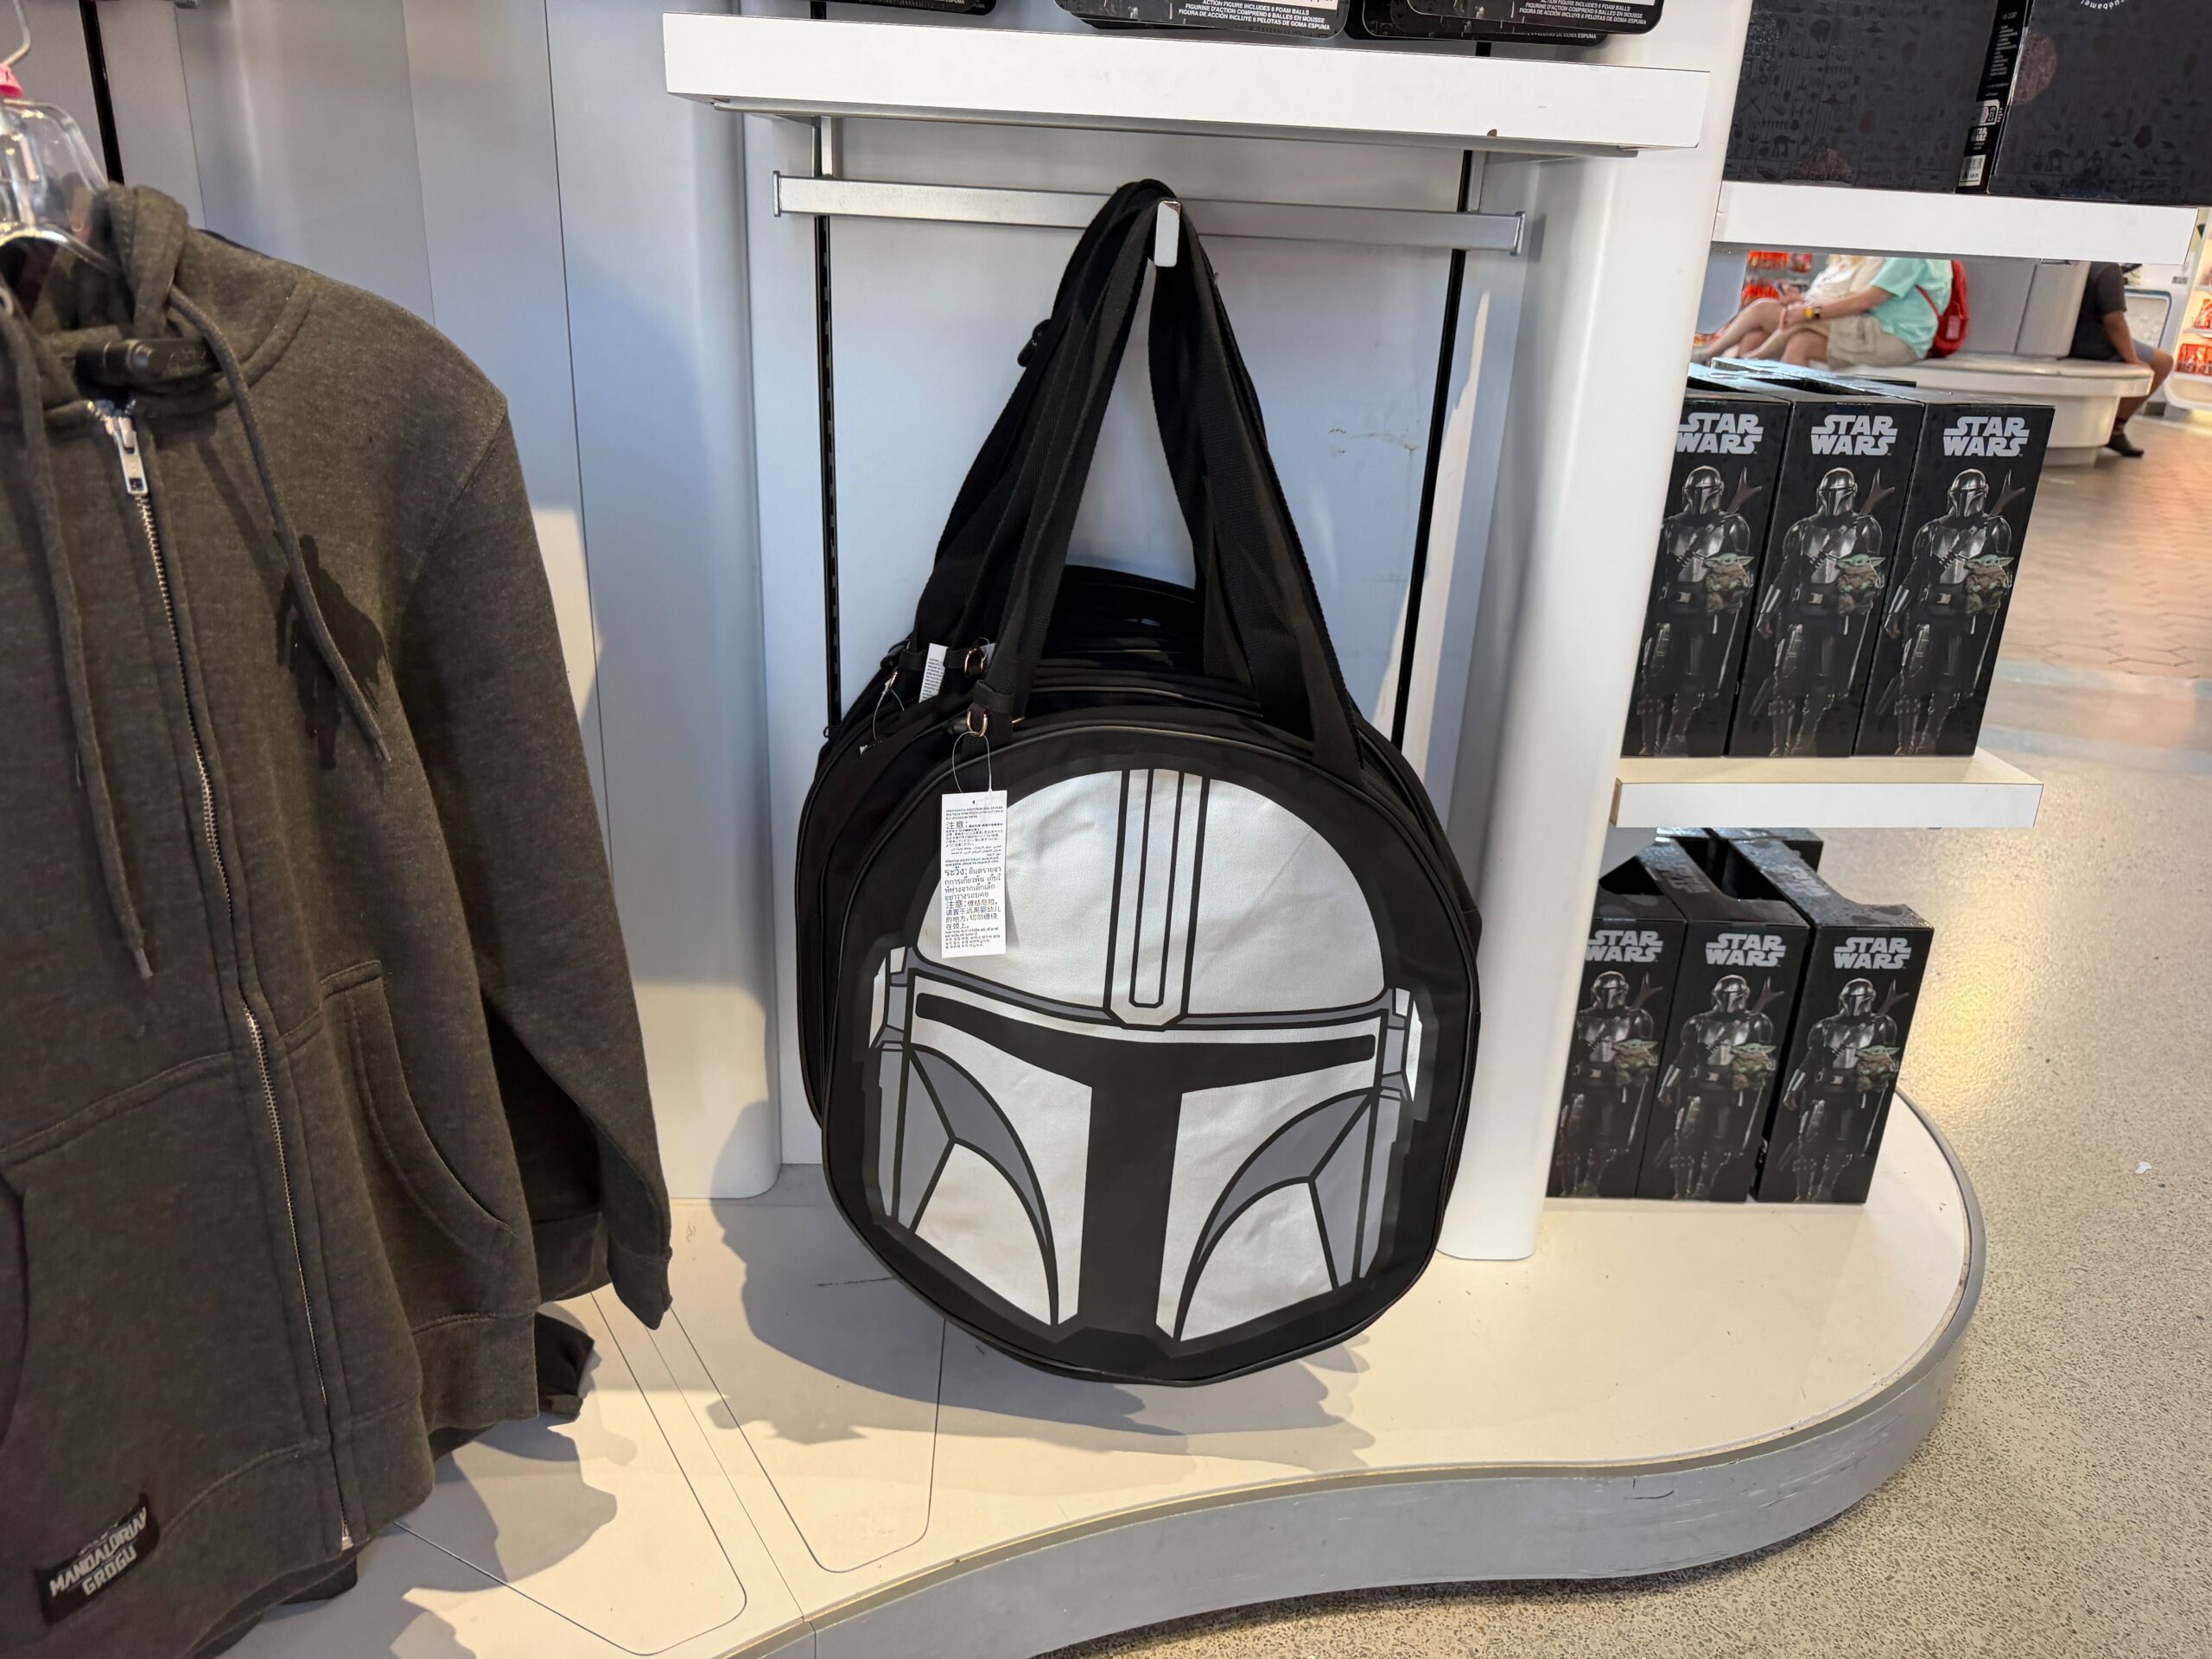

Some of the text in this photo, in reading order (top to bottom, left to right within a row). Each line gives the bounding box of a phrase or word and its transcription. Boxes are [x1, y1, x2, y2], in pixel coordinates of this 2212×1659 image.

[1211, 5, 1236, 14] D'ACTION
[1236, 8, 1267, 17] COMPREND
[1244, 3, 1270, 11] INCLUDES
[1585, 13, 1605, 22] PELOTAS
[1678, 412, 1764, 434] STAR
[1811, 415, 1898, 436] STAR
[1943, 416, 2030, 437] STAR
[1676, 432, 1763, 454] WARS
[1811, 435, 1897, 455] WARS
[1943, 436, 2029, 457] WARS
[1587, 930, 1663, 947] STAR
[1706, 933, 1786, 950] STAR
[1834, 937, 1912, 954] STAR
[1585, 945, 1662, 963] WARS
[1706, 949, 1785, 967] WARS
[1834, 952, 1910, 969] WARS
[82, 1544, 137, 1596] GROGU
